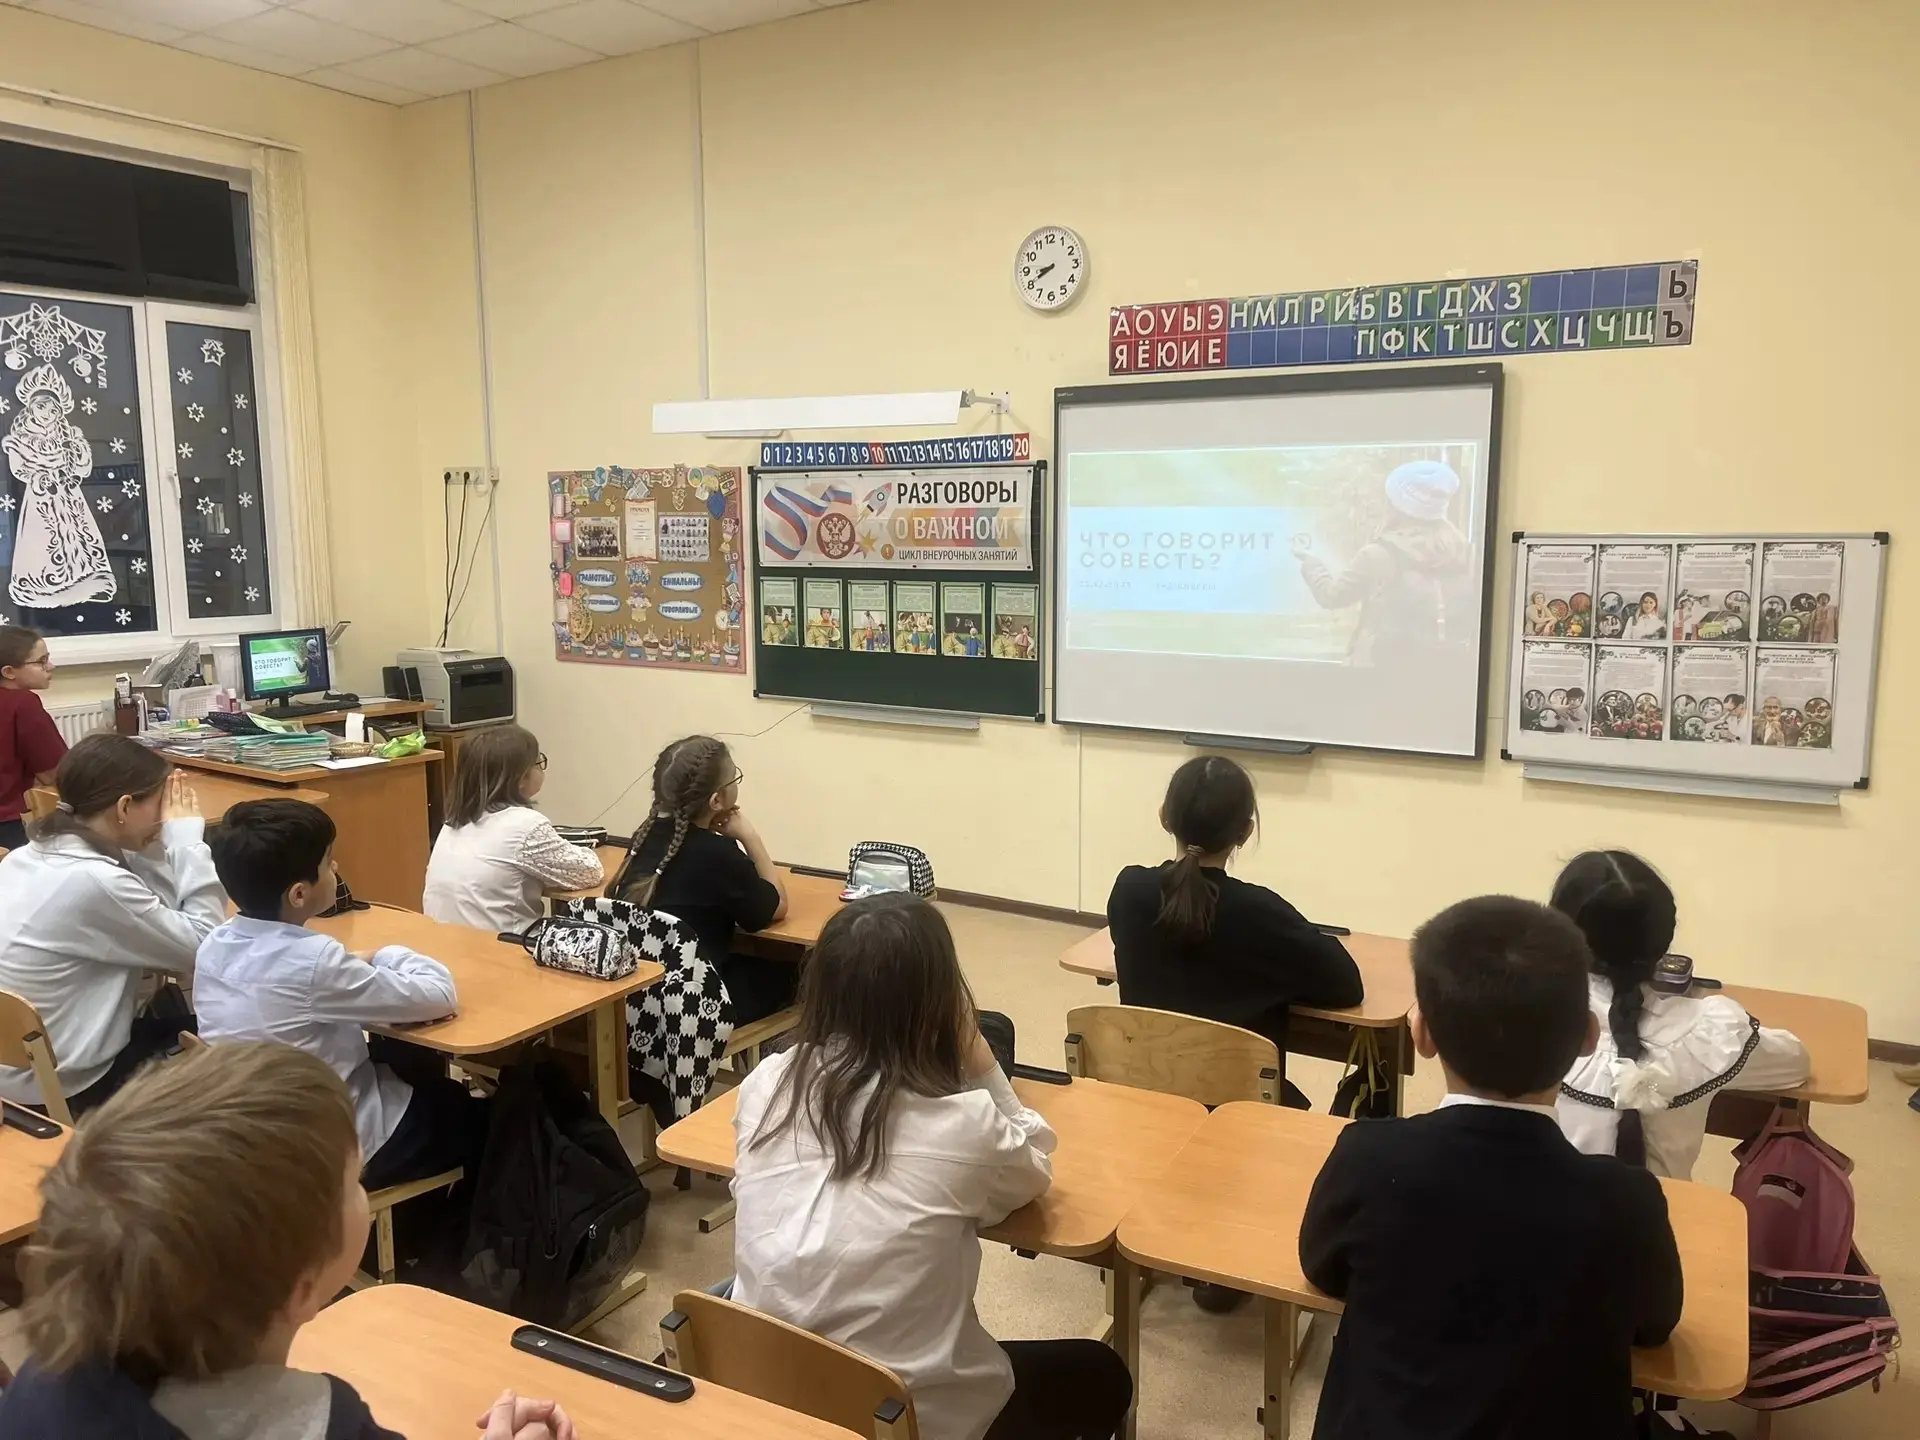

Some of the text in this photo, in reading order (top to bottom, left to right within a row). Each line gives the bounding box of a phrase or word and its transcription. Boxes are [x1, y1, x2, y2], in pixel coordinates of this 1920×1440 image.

[1045, 233, 1055, 244] 12
[1060, 236, 1065, 246] 1
[1035, 240, 1042, 250] 11
[1067, 245, 1074, 256] 2
[1026, 251, 1036, 262] 10
[1072, 258, 1079, 269] 3
[1022, 266, 1030, 276] 9
[1068, 273, 1075, 284] 4
[1027, 280, 1034, 290] 8
[1060, 284, 1067, 295] 5
[1036, 288, 1043, 299] 7
[1047, 291, 1055, 301] 6
[763, 438, 1028, 463] 0 1 2 3 4 5 6 7 8 9 10 11 12 13 14 15 16 17 18 19 20
[897, 480, 1017, 504] РАЗГОВОРЫ
[895, 516, 1008, 540] О ВАЖНОМ
[1080, 531, 1274, 550] ЧТО ГОВОРИТ
[899, 549, 1018, 561] ЦИКЛ ВНЕУРОЧНЫХ ЗАНЯТИЙ
[1080, 552, 1221, 569] СОВЕСТЬ?
